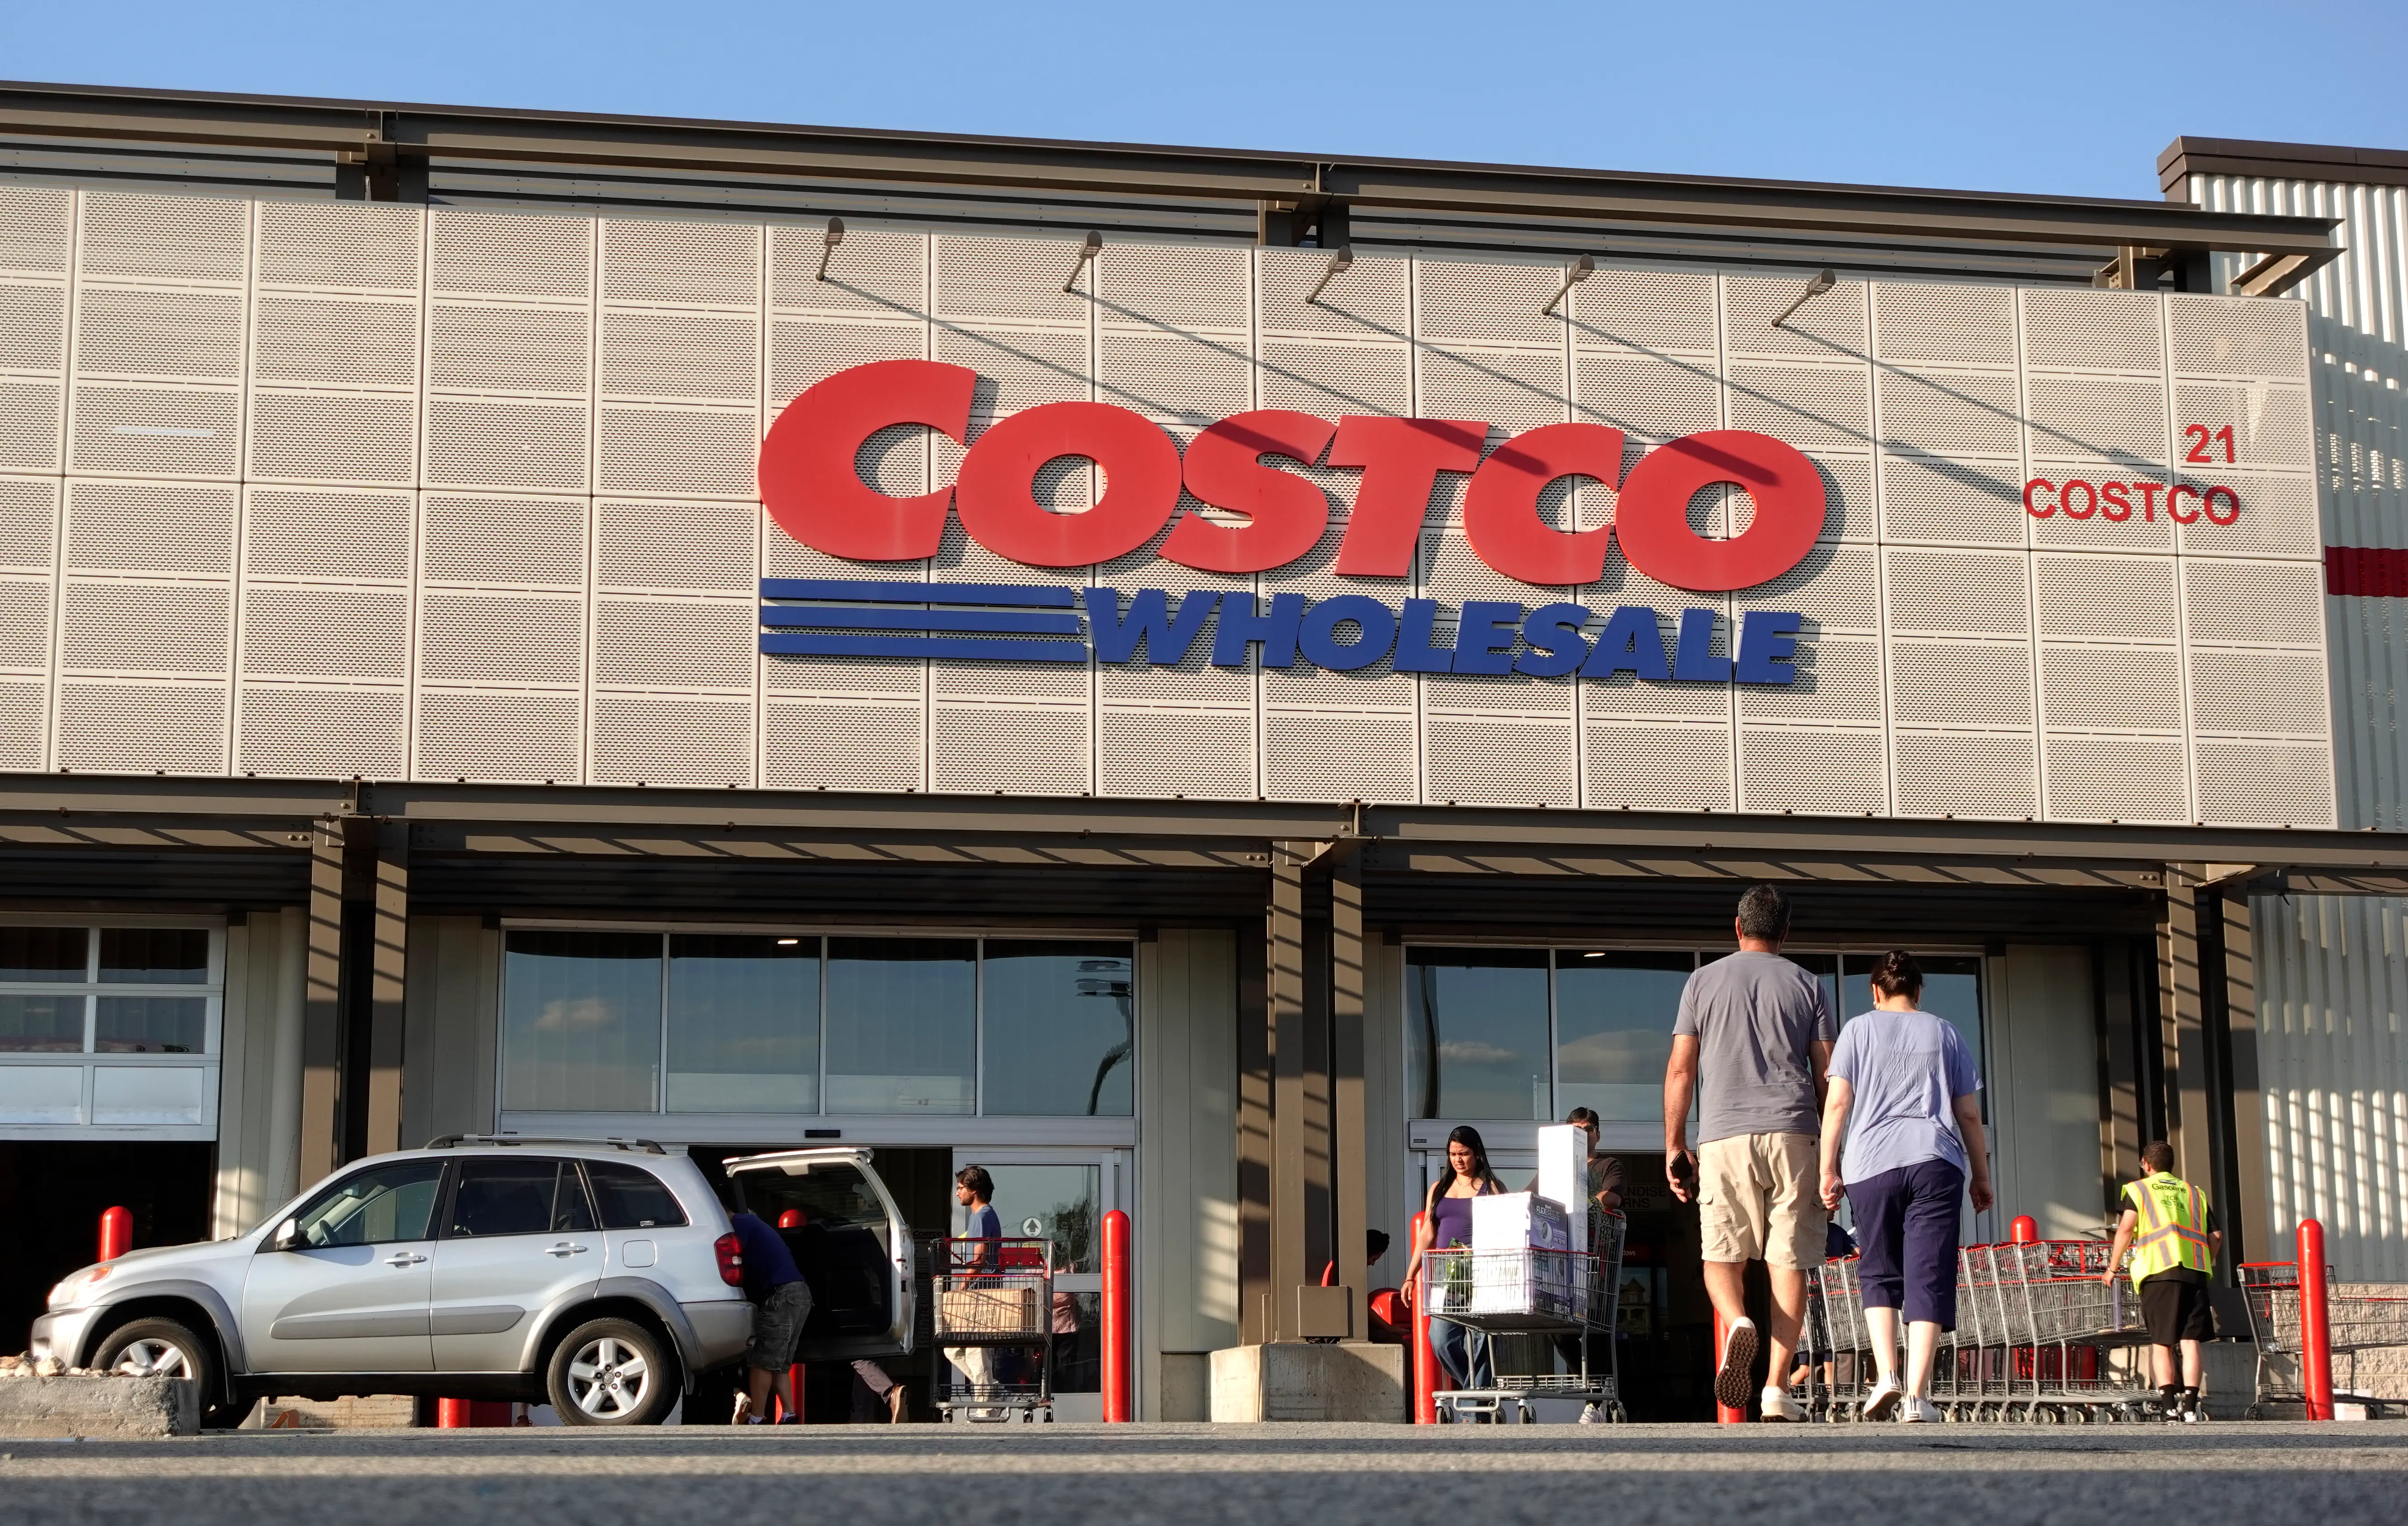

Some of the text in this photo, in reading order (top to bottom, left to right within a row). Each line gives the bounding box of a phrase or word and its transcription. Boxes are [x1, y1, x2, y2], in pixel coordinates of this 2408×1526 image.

[2185, 424, 2235, 463] 21
[758, 360, 1826, 592] COSTCO
[2023, 478, 2240, 526] COSTCO
[1083, 587, 1802, 685] WHOLESALE
[1624, 1198, 1650, 1208] RNS
[1625, 1186, 1667, 1197] NDISE
[2152, 1184, 2186, 1193] Gasoline
